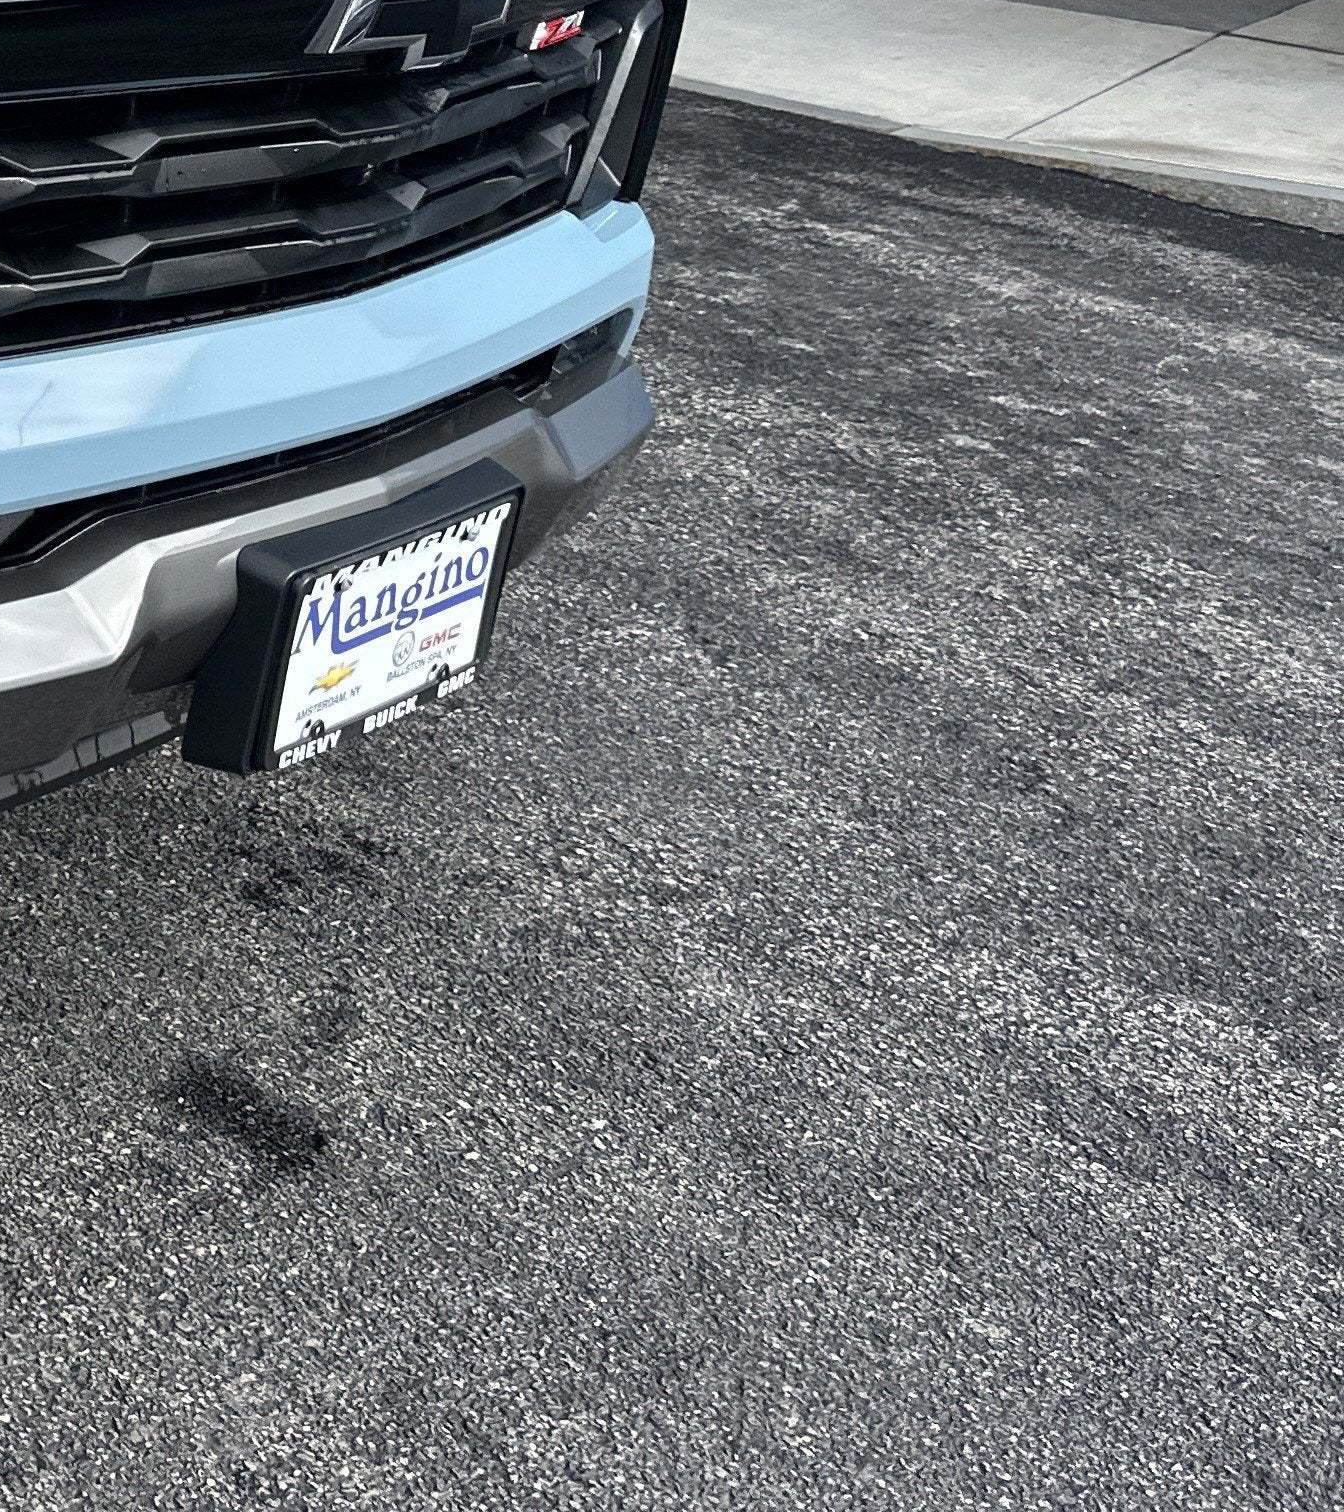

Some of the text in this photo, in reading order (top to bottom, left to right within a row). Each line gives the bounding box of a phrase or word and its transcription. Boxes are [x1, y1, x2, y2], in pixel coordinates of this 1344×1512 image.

[312, 502, 512, 596] MANGINO
[291, 547, 490, 655] Mangino
[386, 655, 426, 682] BALLSTON
[446, 644, 458, 656] NY
[418, 623, 462, 653] GMC
[278, 666, 476, 769] CHEVY BUICK GMC
[349, 684, 362, 699] NY
